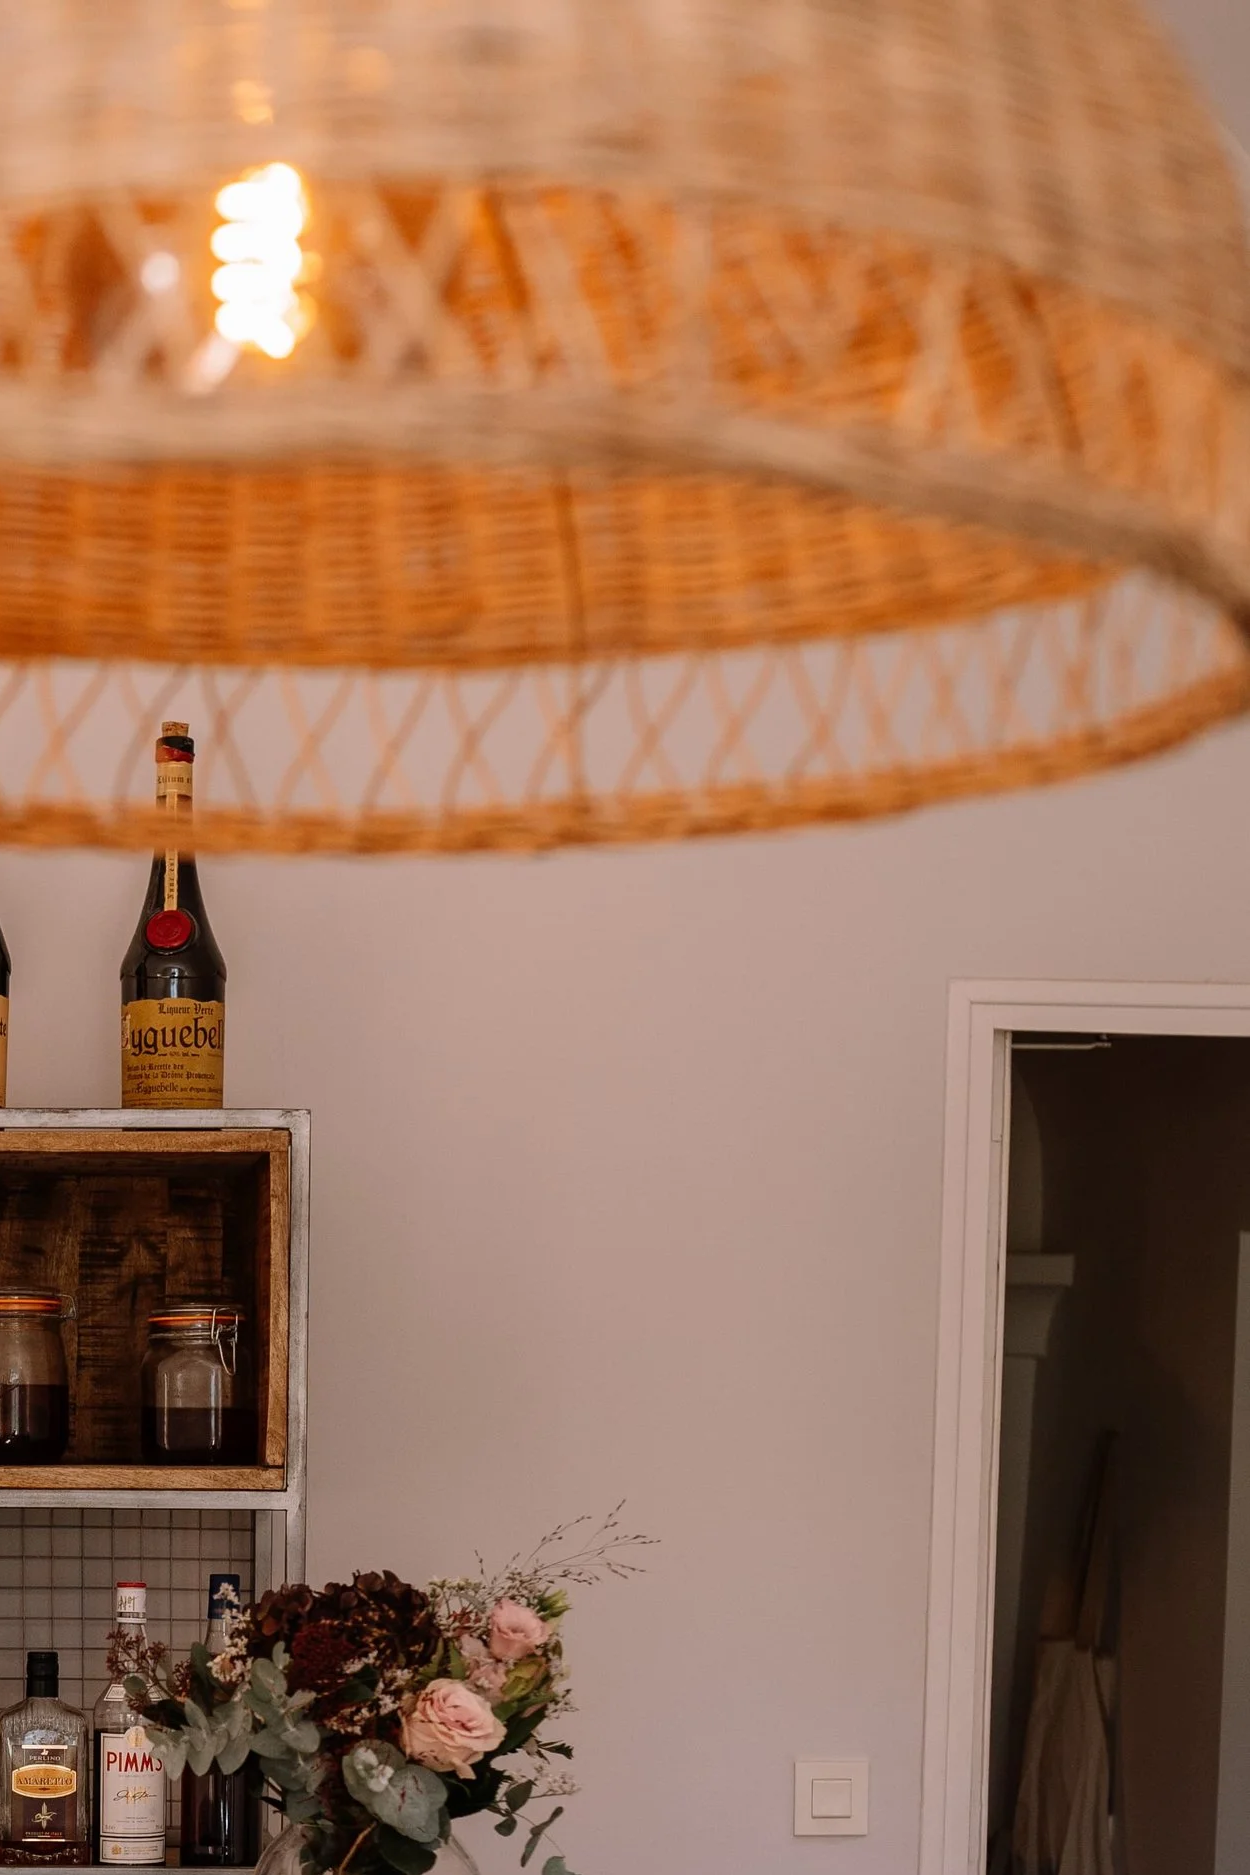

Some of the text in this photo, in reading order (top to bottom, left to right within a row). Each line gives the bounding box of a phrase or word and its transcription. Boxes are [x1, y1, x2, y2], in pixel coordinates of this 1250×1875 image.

[158, 1002, 214, 1016] Liqueur Verte
[18, 1777, 73, 1785] AMARETTO
